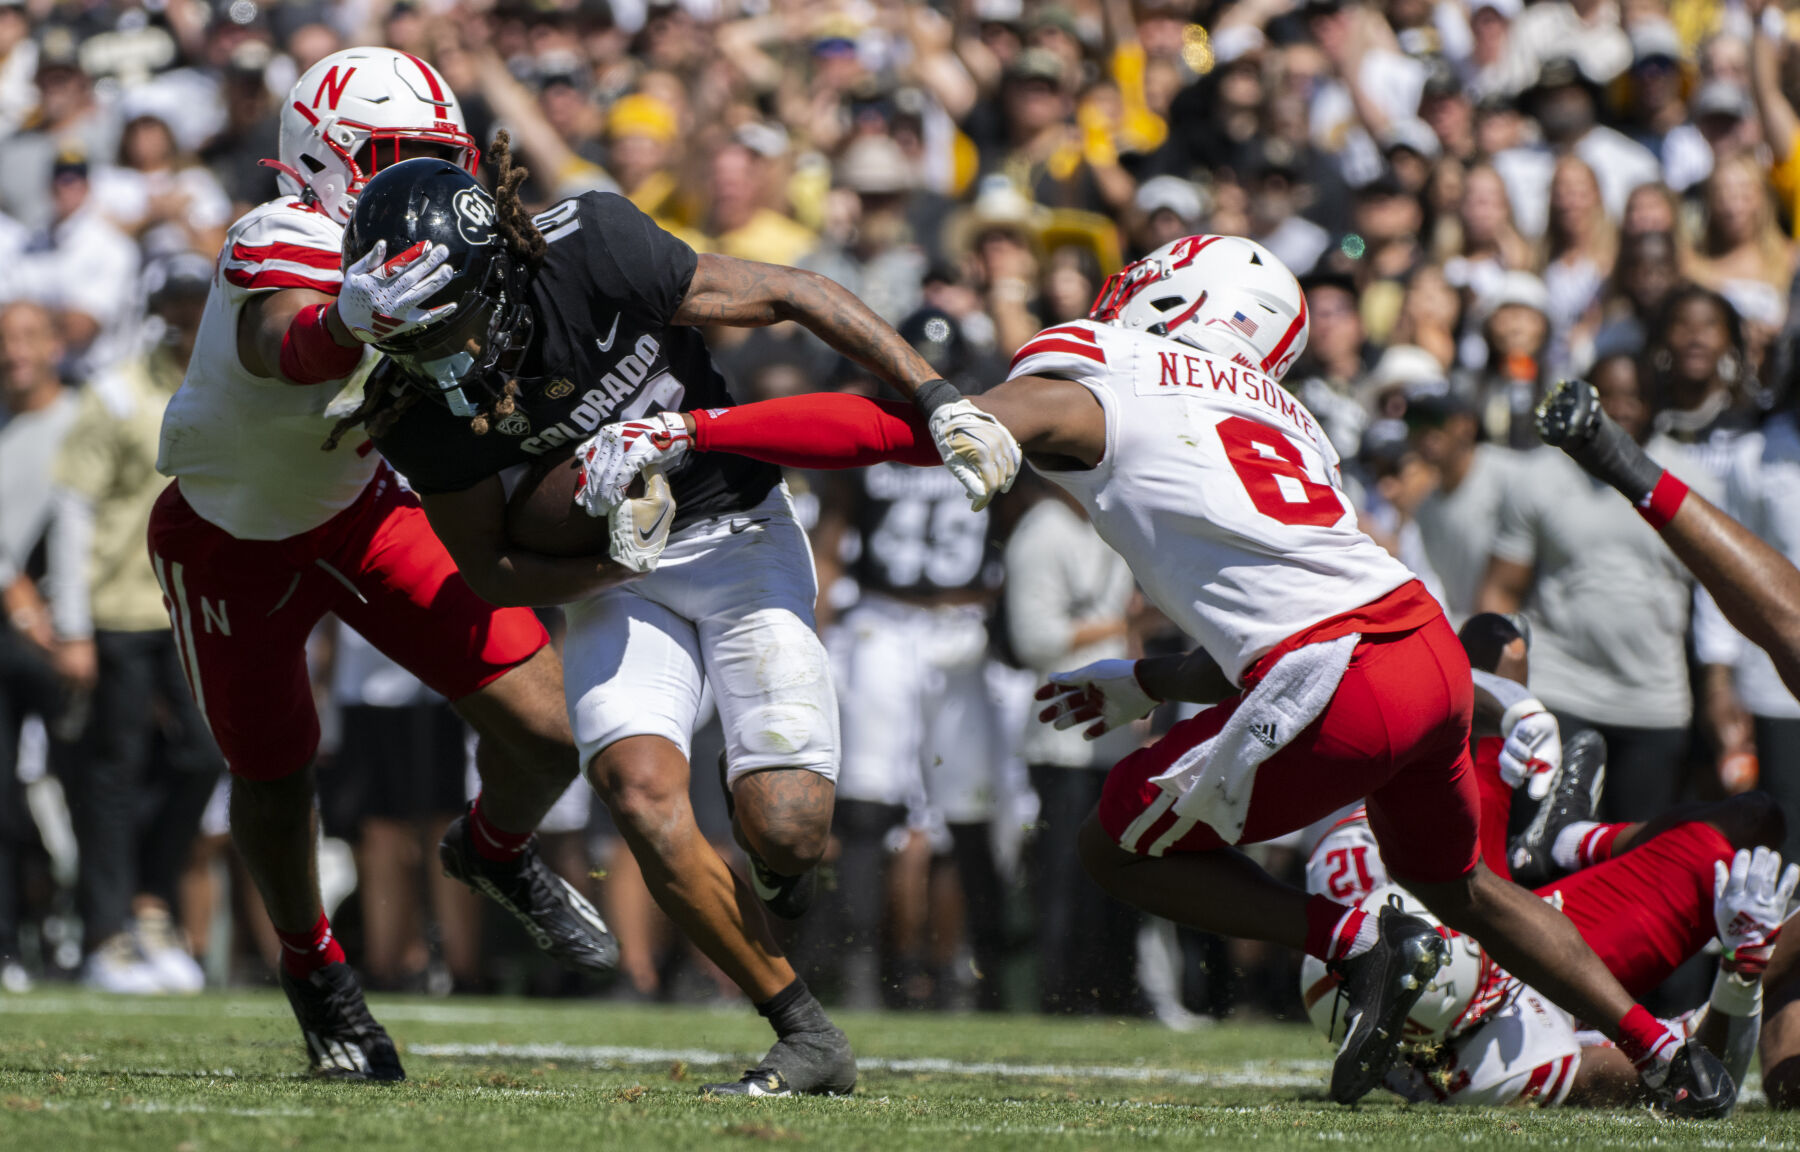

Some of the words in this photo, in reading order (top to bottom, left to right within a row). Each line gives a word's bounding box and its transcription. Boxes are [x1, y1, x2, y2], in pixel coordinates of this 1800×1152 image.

[312, 65, 357, 111] N
[520, 333, 660, 455] COLORADO
[1158, 351, 1318, 443] NEWSOME
[200, 594, 232, 636] N
